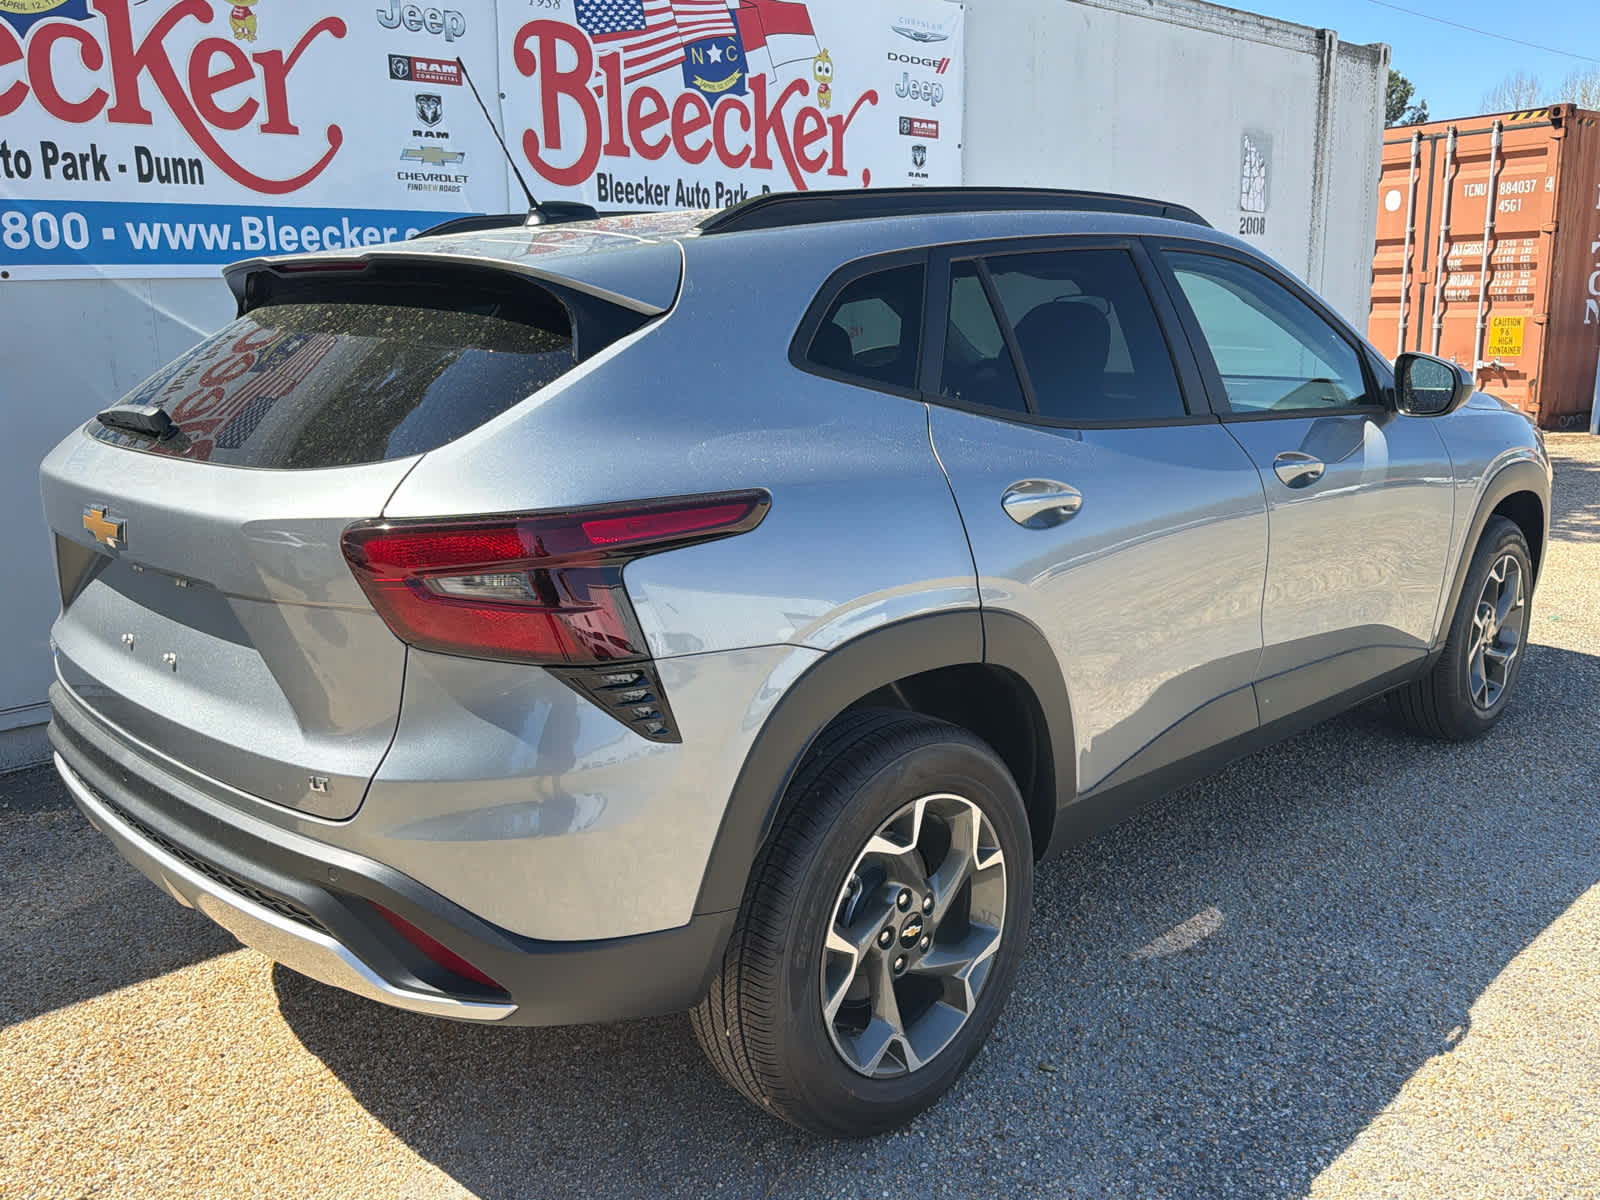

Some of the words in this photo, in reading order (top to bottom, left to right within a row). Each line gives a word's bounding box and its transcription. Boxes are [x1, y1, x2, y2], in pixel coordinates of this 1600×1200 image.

[376, 0, 467, 43] Jeep
[691, 47, 705, 65] N
[725, 45, 739, 62] C
[887, 52, 941, 68] DODGE
[414, 61, 459, 75] RAM
[895, 72, 944, 107] Jeep
[513, 19, 879, 190] Bleecker
[411, 129, 450, 140] RAM
[0, 139, 33, 180] to
[40, 140, 112, 182] Park
[134, 145, 205, 185] Dunn
[397, 171, 470, 184] CHEVROLET
[407, 183, 423, 192] FIND
[439, 184, 461, 193] ROADS
[597, 172, 671, 207] Bleecker
[676, 178, 711, 210] Auto
[1463, 183, 1488, 198] TCNU
[1499, 179, 1538, 196] 884037
[1545, 176, 1555, 192] 4
[1498, 198, 1522, 213] 45G1
[1, 211, 90, 250] 800
[1239, 216, 1266, 236] 2008
[1493, 317, 1521, 327] CAUTION
[1488, 345, 1521, 355] CONTAINER
[1498, 336, 1514, 346] HIGH
[308, 775, 329, 793] LT
